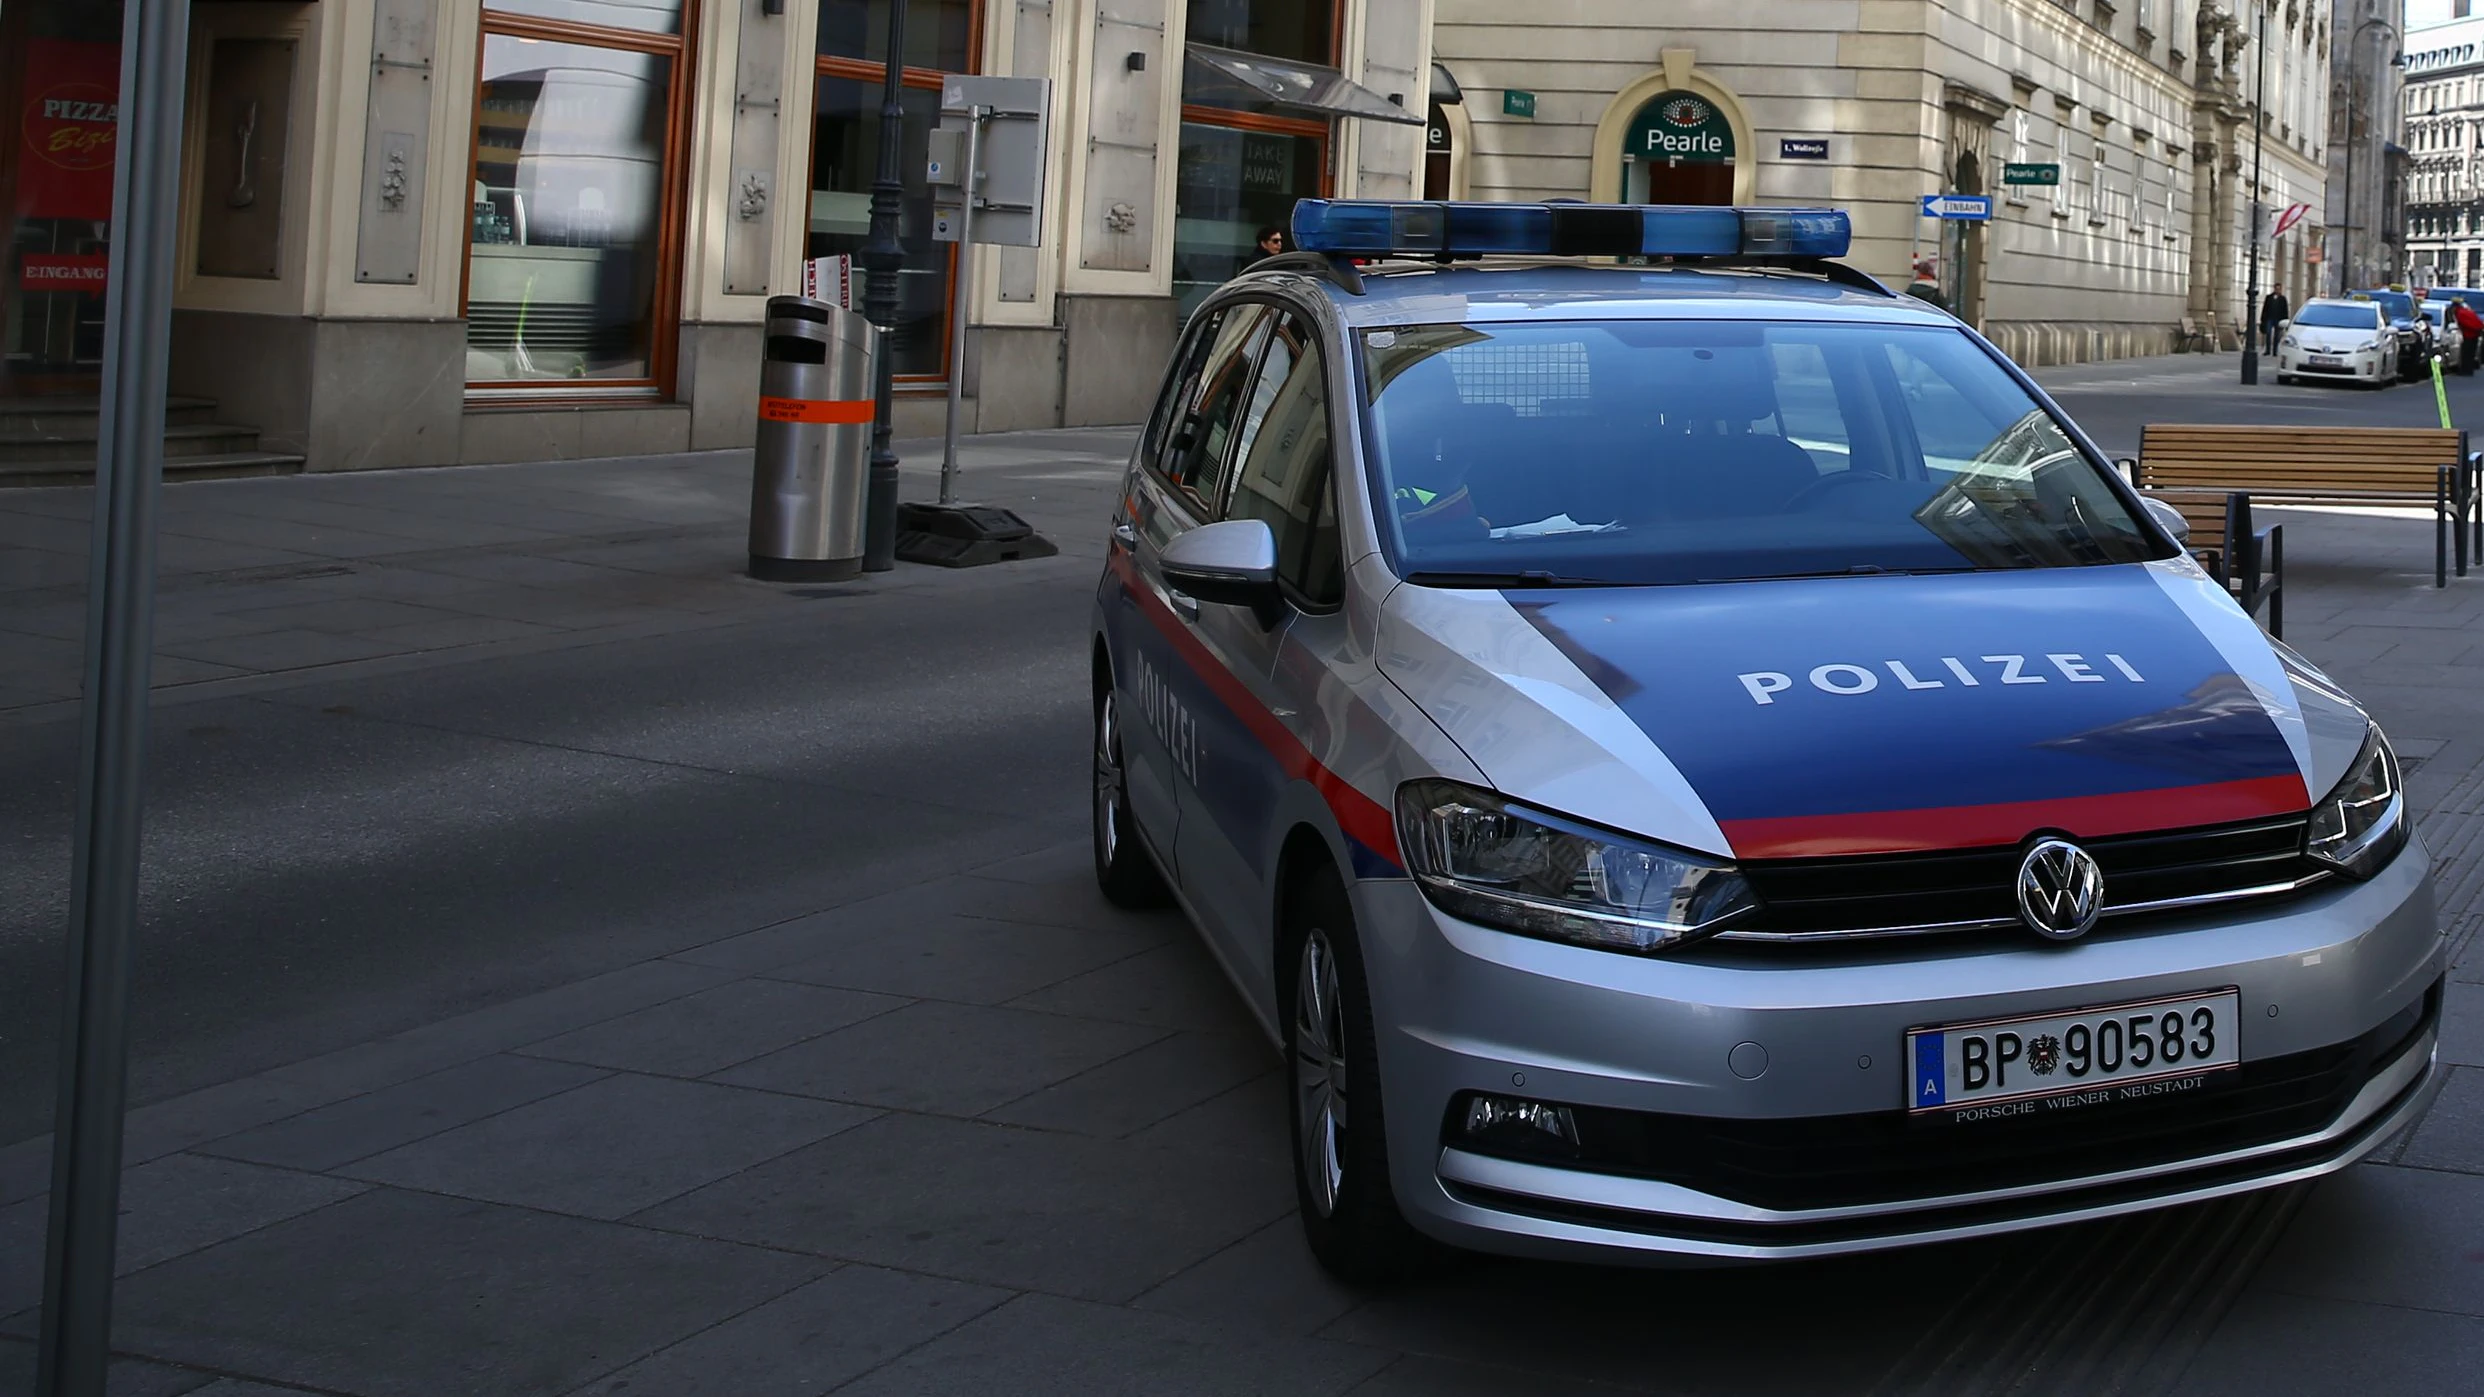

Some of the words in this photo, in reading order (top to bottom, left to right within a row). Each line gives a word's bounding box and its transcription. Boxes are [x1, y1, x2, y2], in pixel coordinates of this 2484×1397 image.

[44, 98, 118, 122] PIZZA
[1246, 141, 1284, 164] TAKE
[1647, 129, 1723, 153] Pearle
[1244, 165, 1283, 186] AWAY
[1944, 200, 1983, 213] EINBAHN
[26, 265, 105, 280] EINGANG
[1737, 653, 2146, 706] POLIZEI
[1137, 649, 1197, 787] POLIZEI
[1923, 1078, 1938, 1097] A
[1961, 1031, 2023, 1091] BP
[2064, 1006, 2216, 1078] 90583
[1955, 1101, 2036, 1124] PORSCHE
[2045, 1091, 2110, 1110] WIENER
[2119, 1076, 2205, 1101] NEUSTADT
